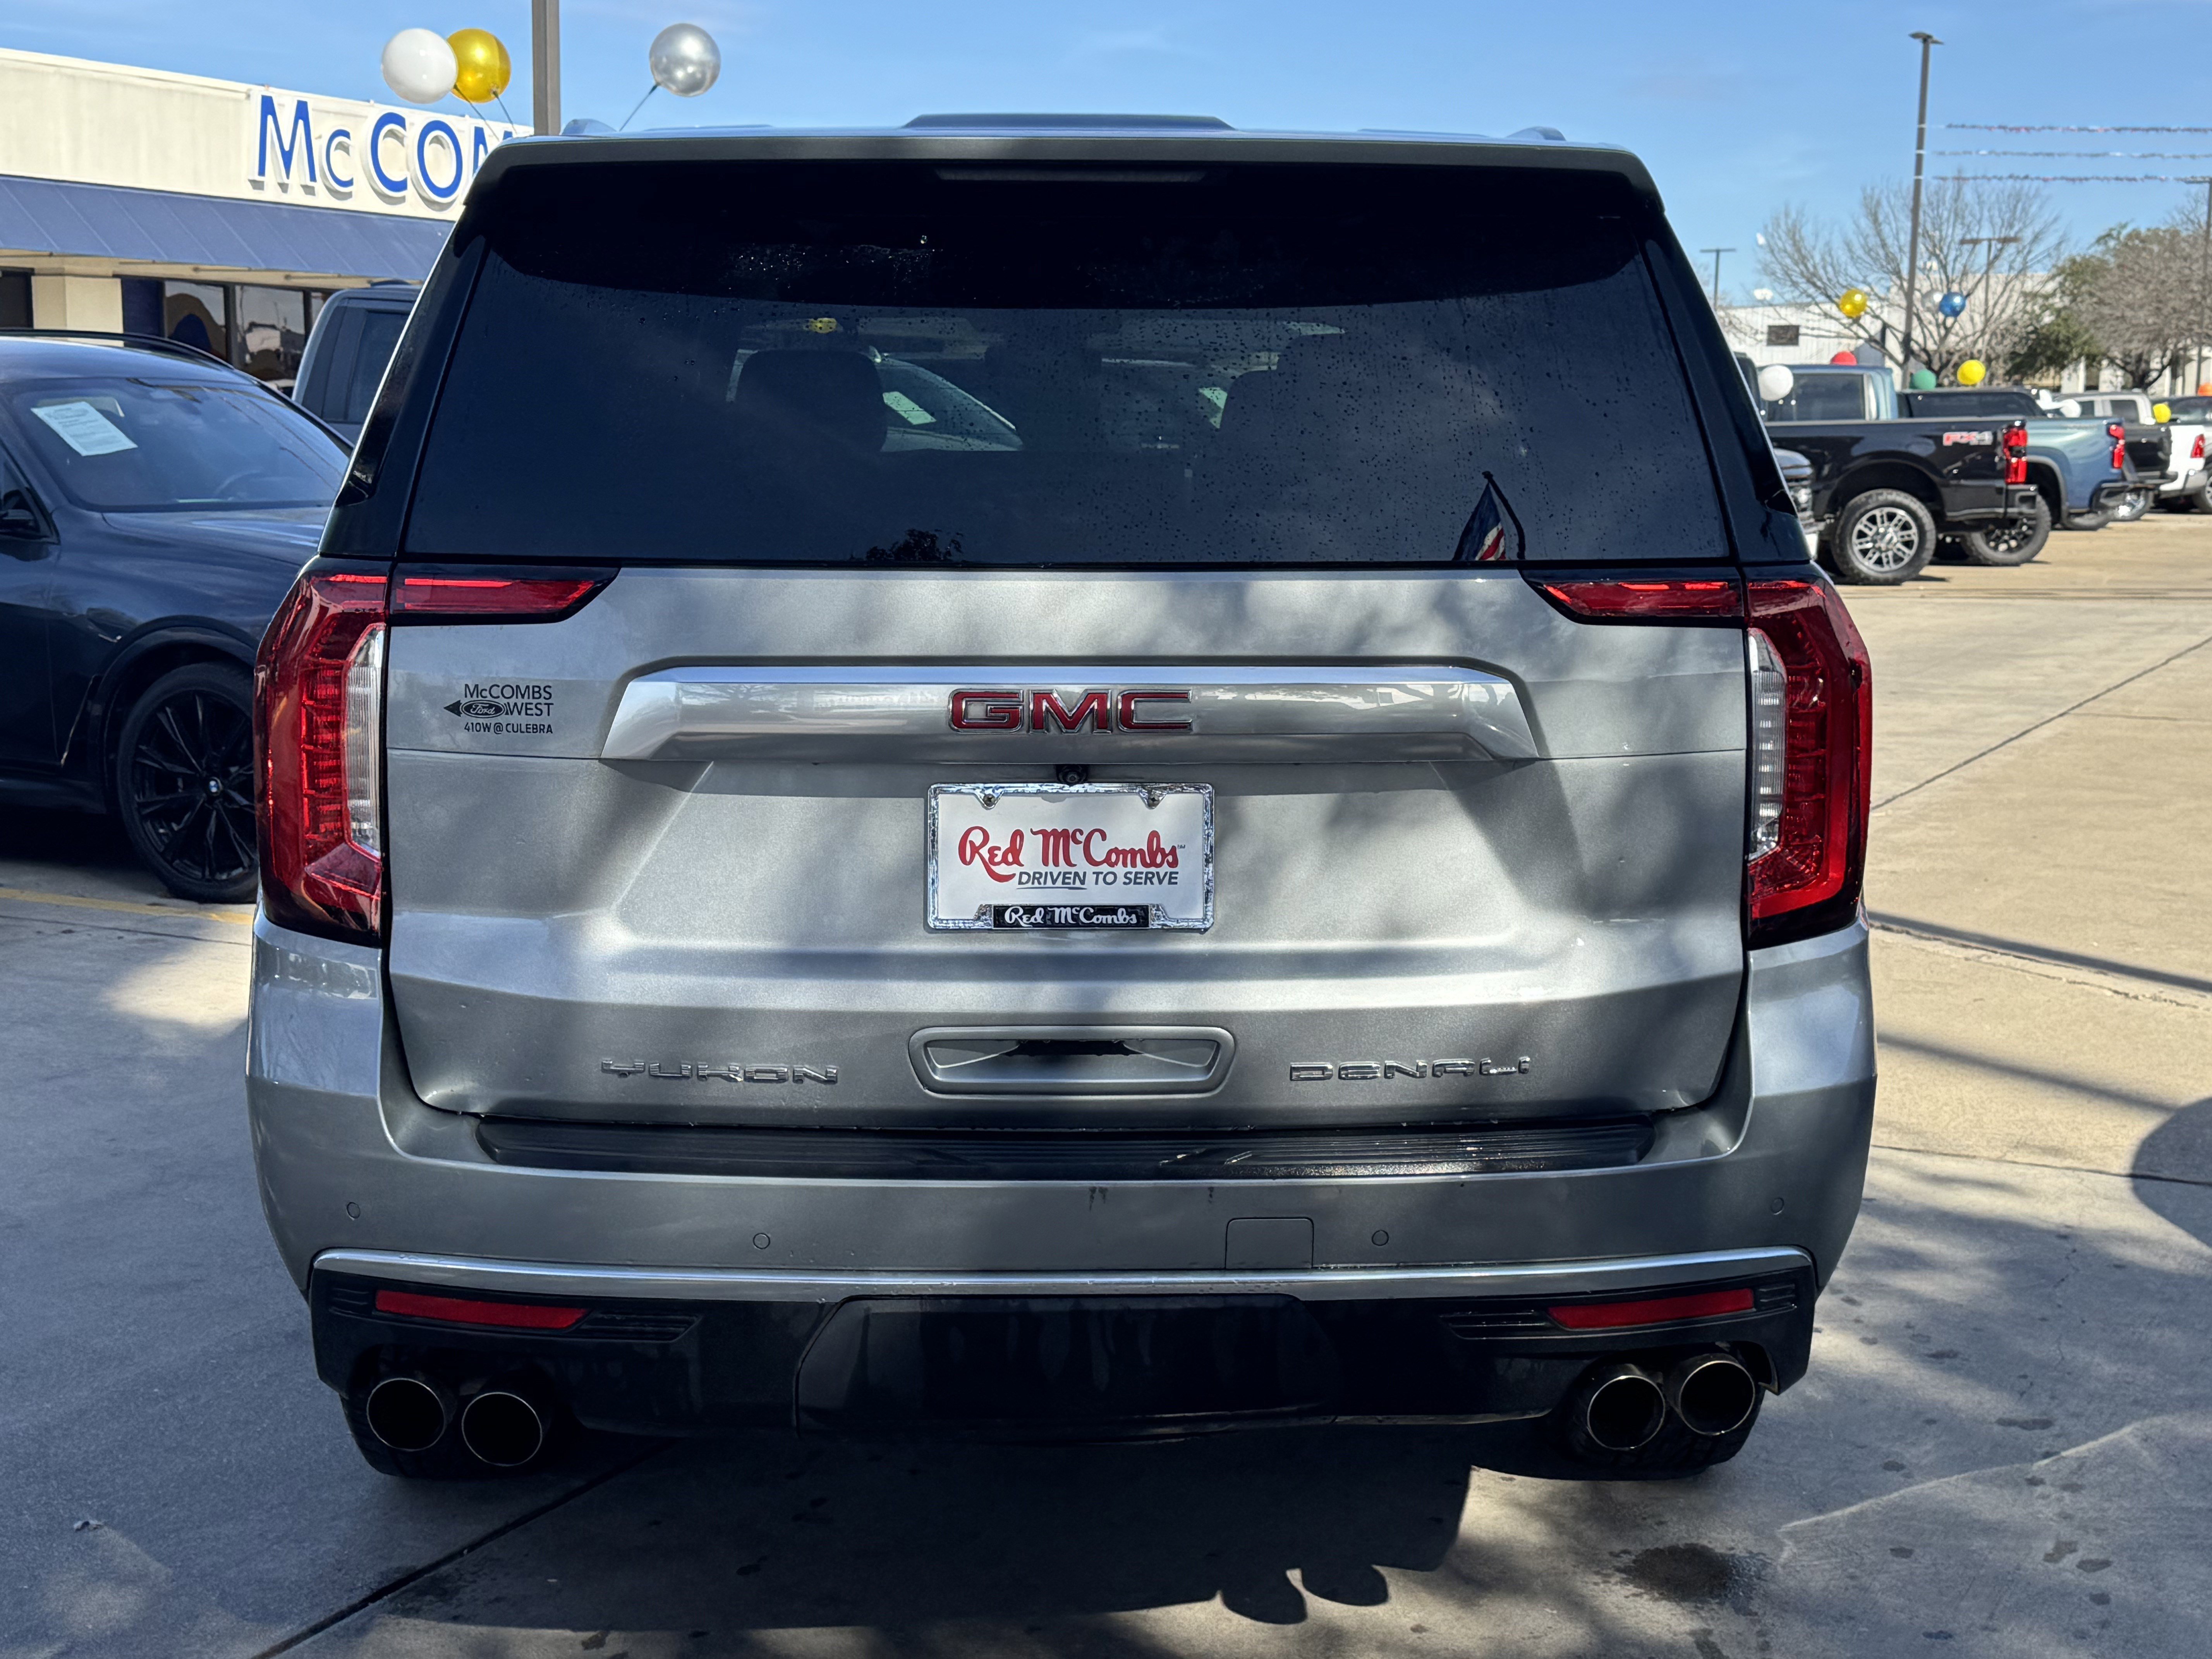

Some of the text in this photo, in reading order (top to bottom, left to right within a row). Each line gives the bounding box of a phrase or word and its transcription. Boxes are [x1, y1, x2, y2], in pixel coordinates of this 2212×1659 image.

[464, 684, 552, 700] McCOMBS
[470, 702, 554, 716] Ford WEST
[948, 688, 1193, 734] GMC
[505, 723, 553, 734] CULEBRA
[958, 826, 1179, 883] Red McCombs
[1017, 871, 1179, 886] DRIVEN TO SERVE
[1005, 907, 1137, 927] Red McCombs
[601, 1059, 838, 1084] YUKON
[1290, 1056, 1530, 1081] DENALI
